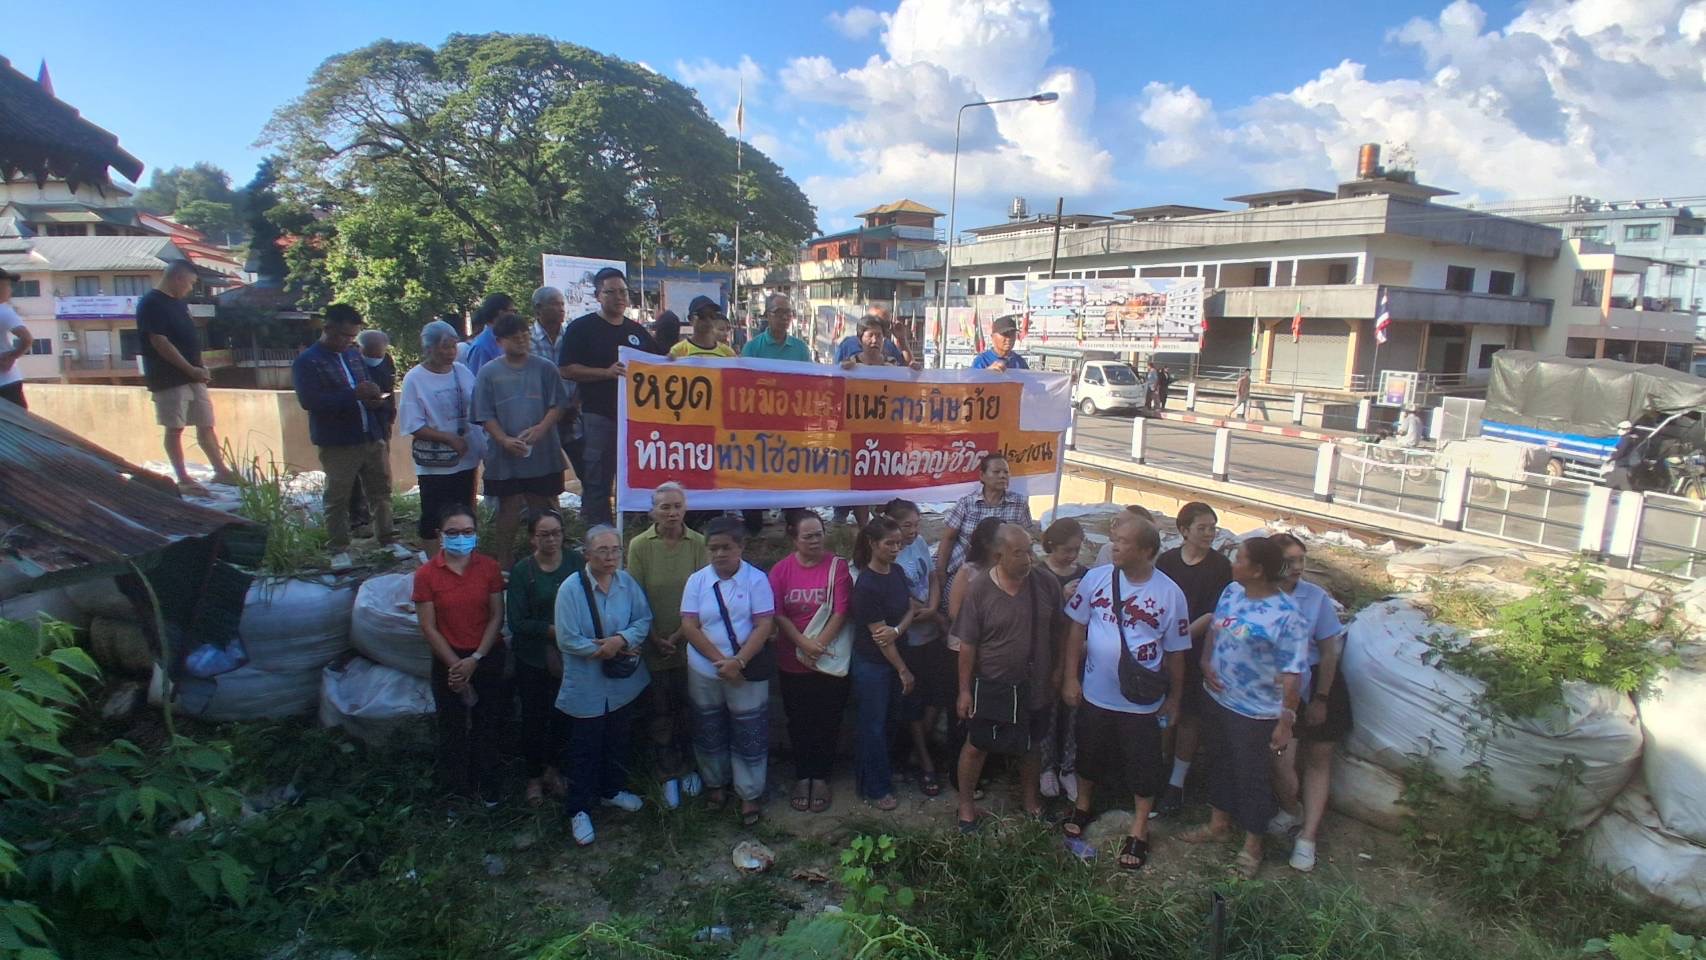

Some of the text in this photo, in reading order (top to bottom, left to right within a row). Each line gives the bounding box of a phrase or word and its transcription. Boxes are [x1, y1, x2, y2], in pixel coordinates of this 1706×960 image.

[633, 373, 712, 421] หยุด
[635, 431, 713, 470] ทำลาย
[1102, 612, 1137, 630] ENOY
[1137, 642, 1158, 662] 23
